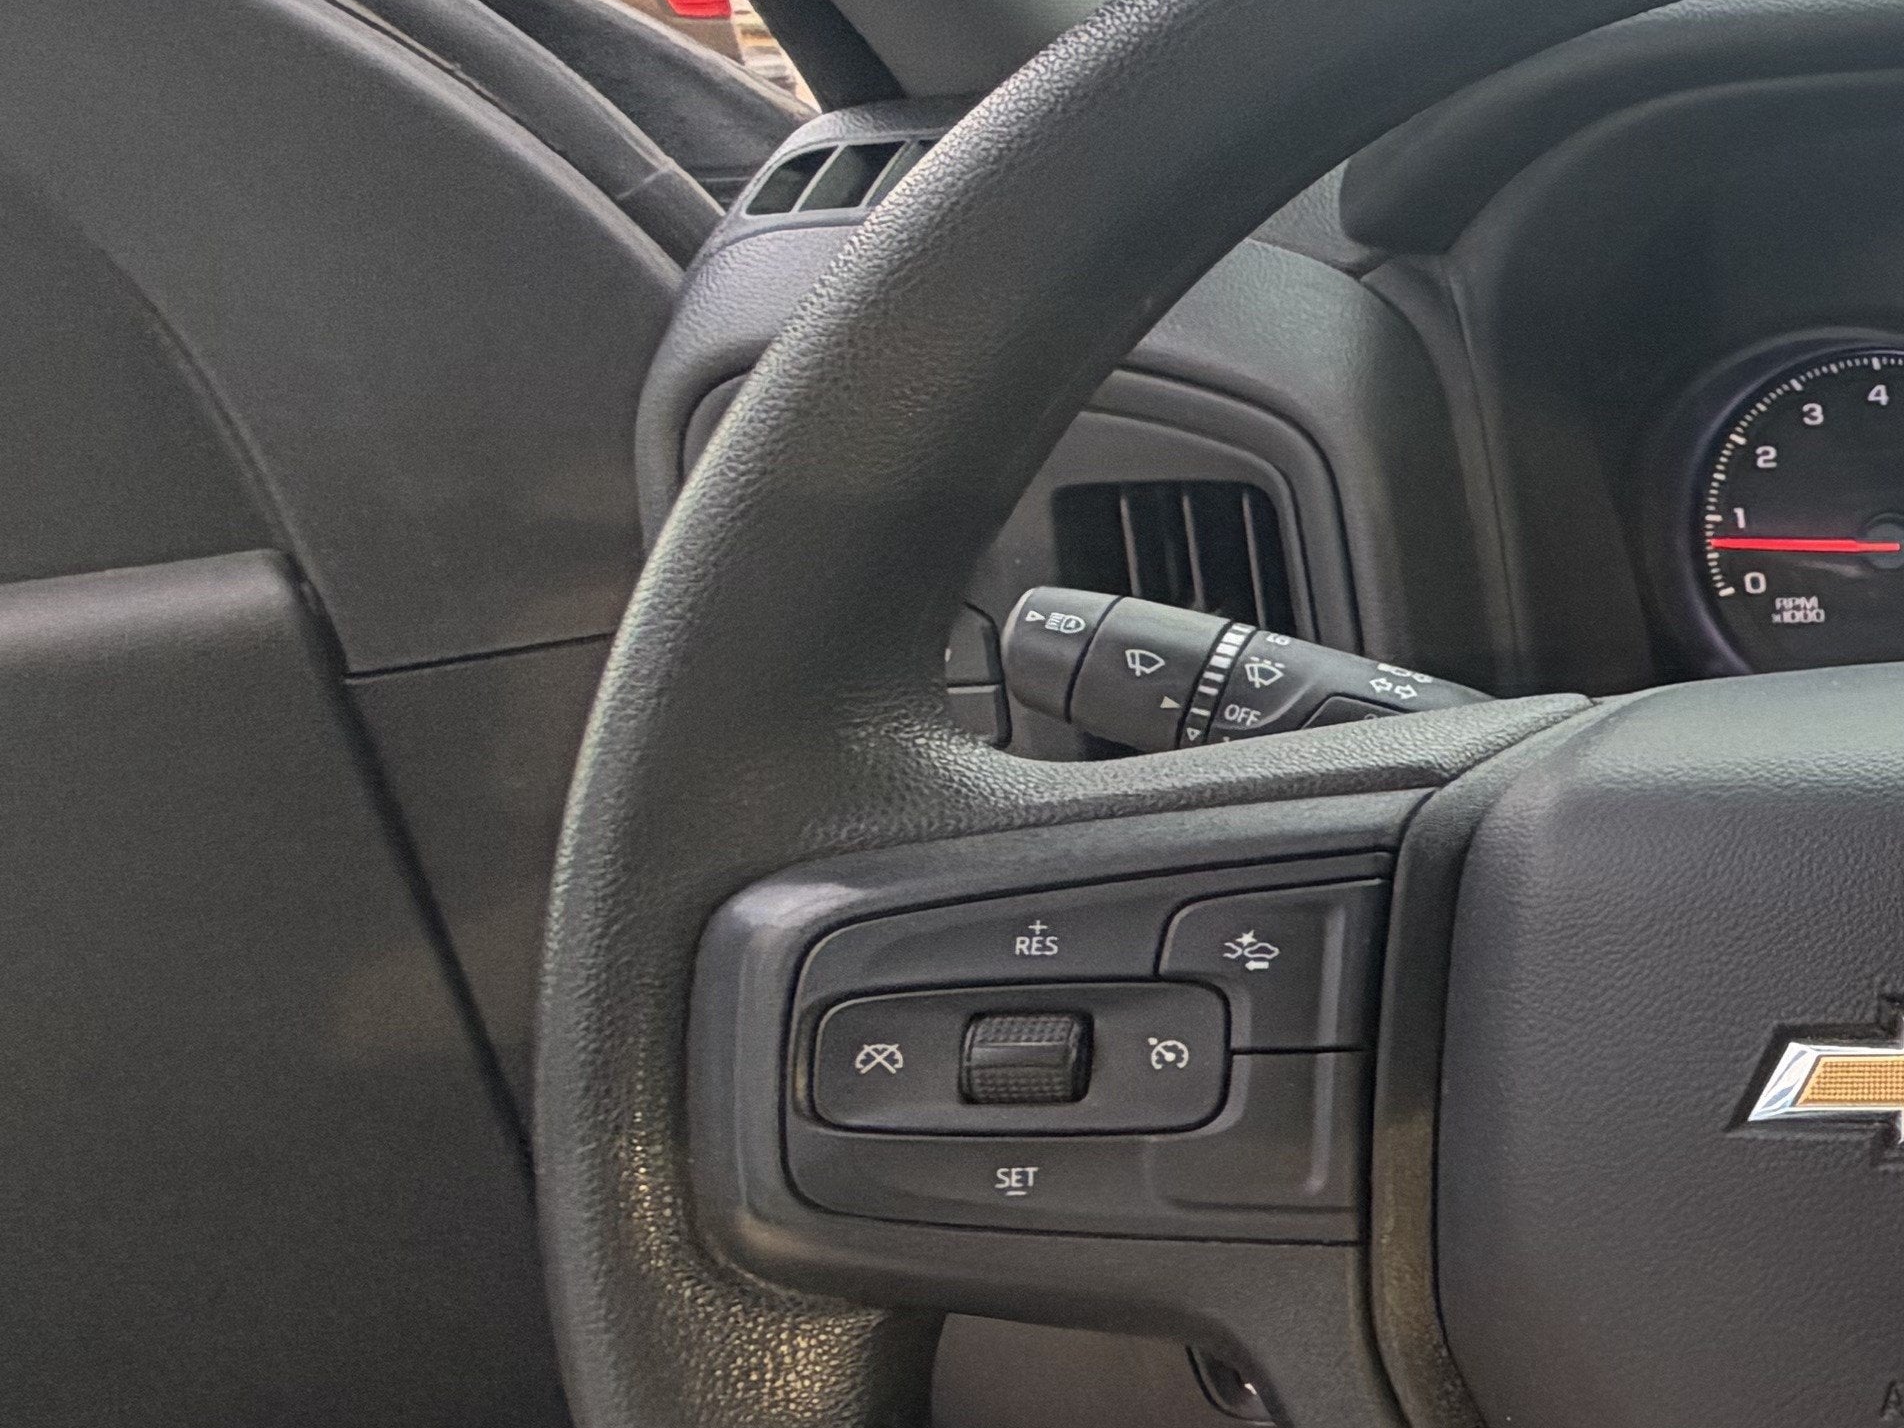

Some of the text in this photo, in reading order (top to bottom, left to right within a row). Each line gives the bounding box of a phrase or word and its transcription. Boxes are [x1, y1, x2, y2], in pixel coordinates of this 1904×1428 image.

[1868, 384, 1889, 406] 4
[1802, 403, 1824, 425] 3
[1756, 446, 1778, 468] 2
[1733, 507, 1747, 529] 1
[1744, 573, 1767, 595] 0
[1775, 597, 1818, 611] RPM
[1224, 704, 1262, 727] OFF
[1015, 936, 1058, 956] RES
[995, 1167, 1038, 1189] SET
